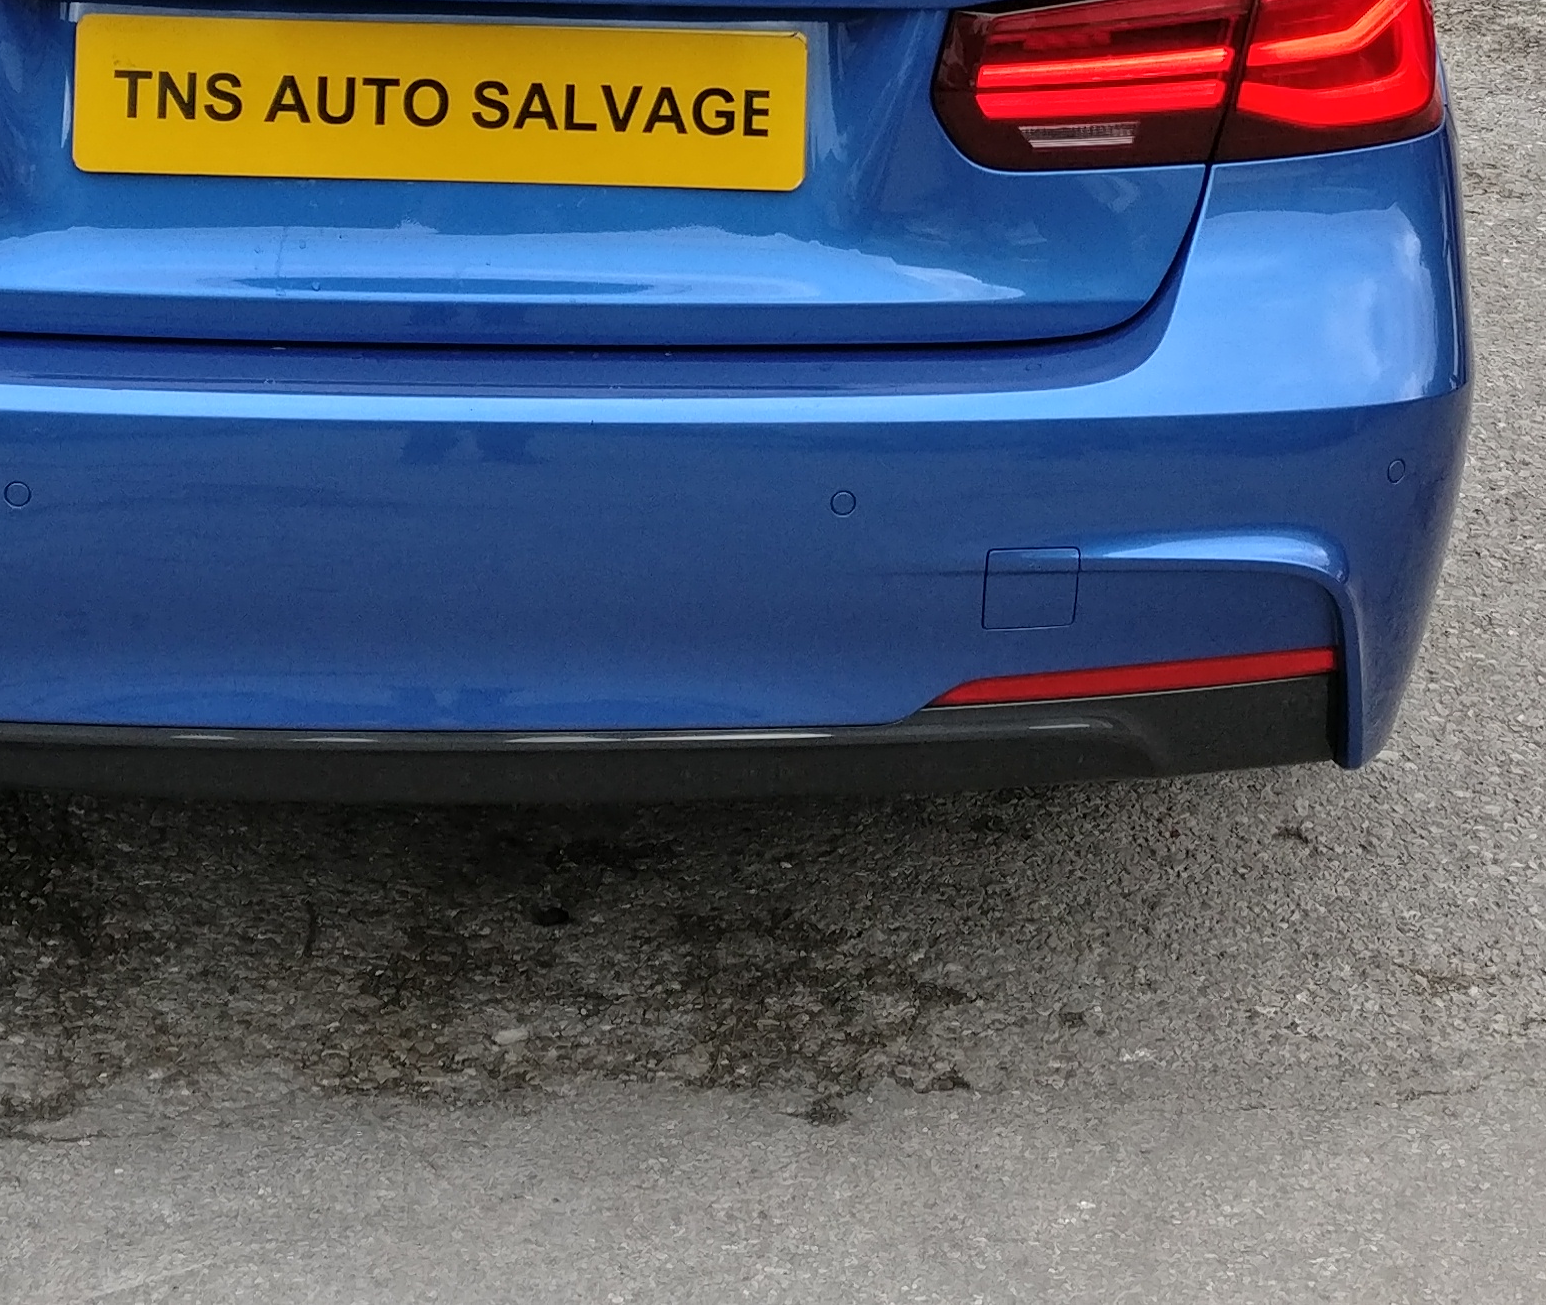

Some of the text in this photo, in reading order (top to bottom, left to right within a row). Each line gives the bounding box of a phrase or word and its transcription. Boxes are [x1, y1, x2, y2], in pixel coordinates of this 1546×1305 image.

[113, 69, 770, 138] TNS AUTO SALVAGE
